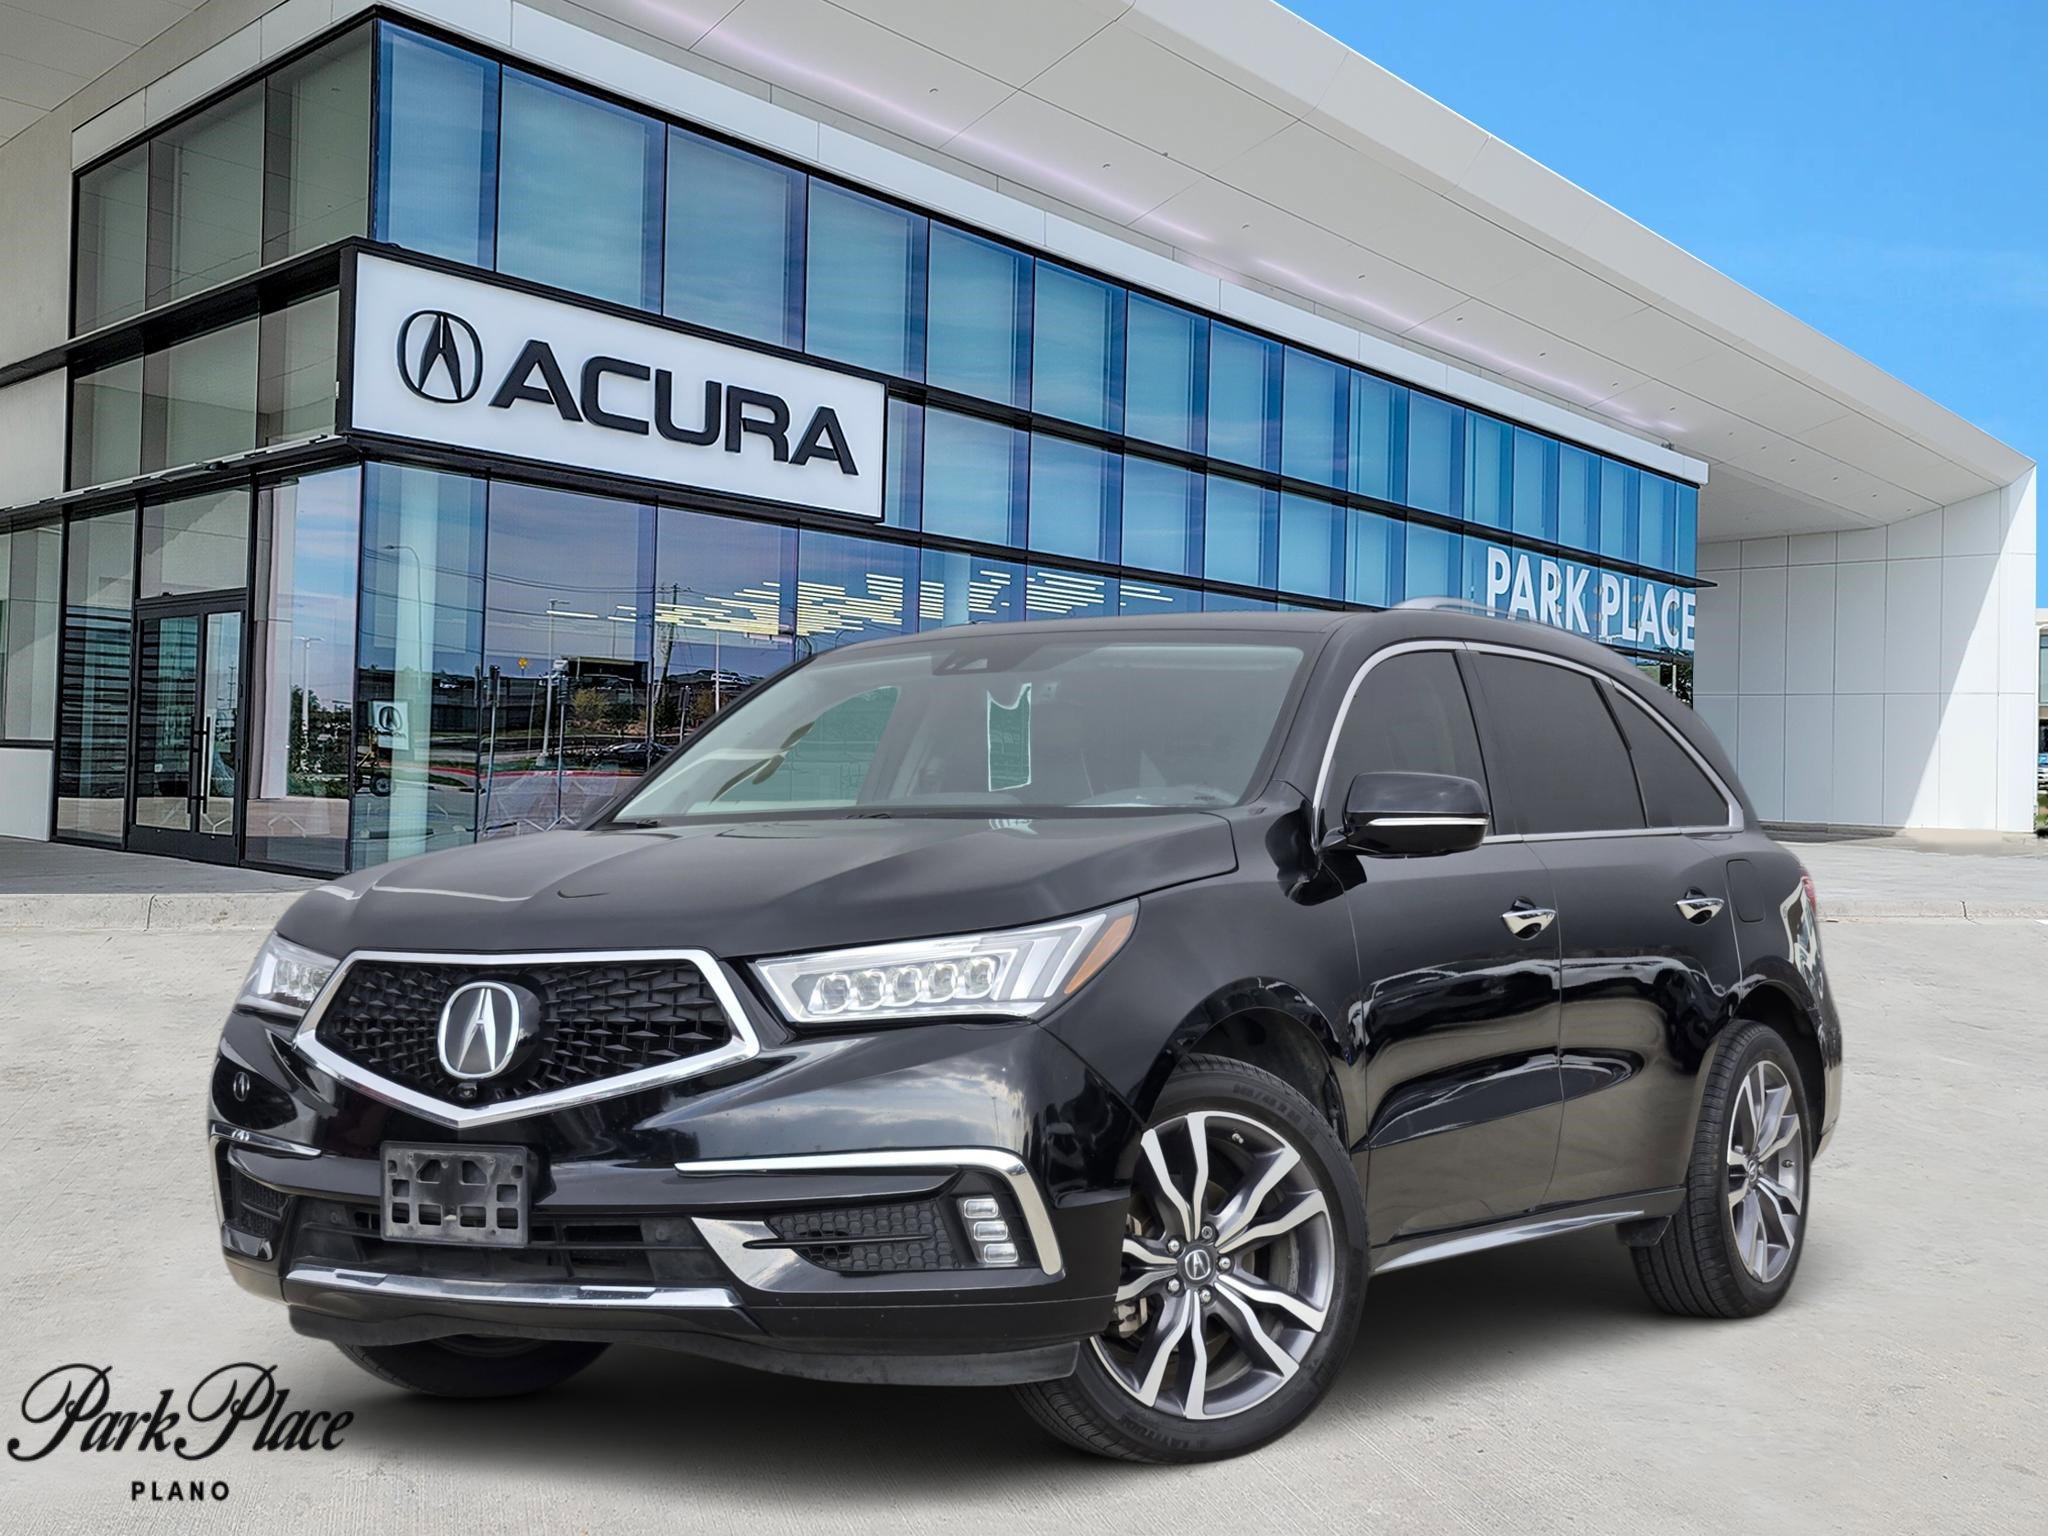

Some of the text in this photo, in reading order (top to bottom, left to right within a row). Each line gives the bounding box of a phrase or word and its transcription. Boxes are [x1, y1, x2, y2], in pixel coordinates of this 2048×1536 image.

[489, 339, 859, 476] ACURA
[1487, 546, 1696, 650] PARK PLACE
